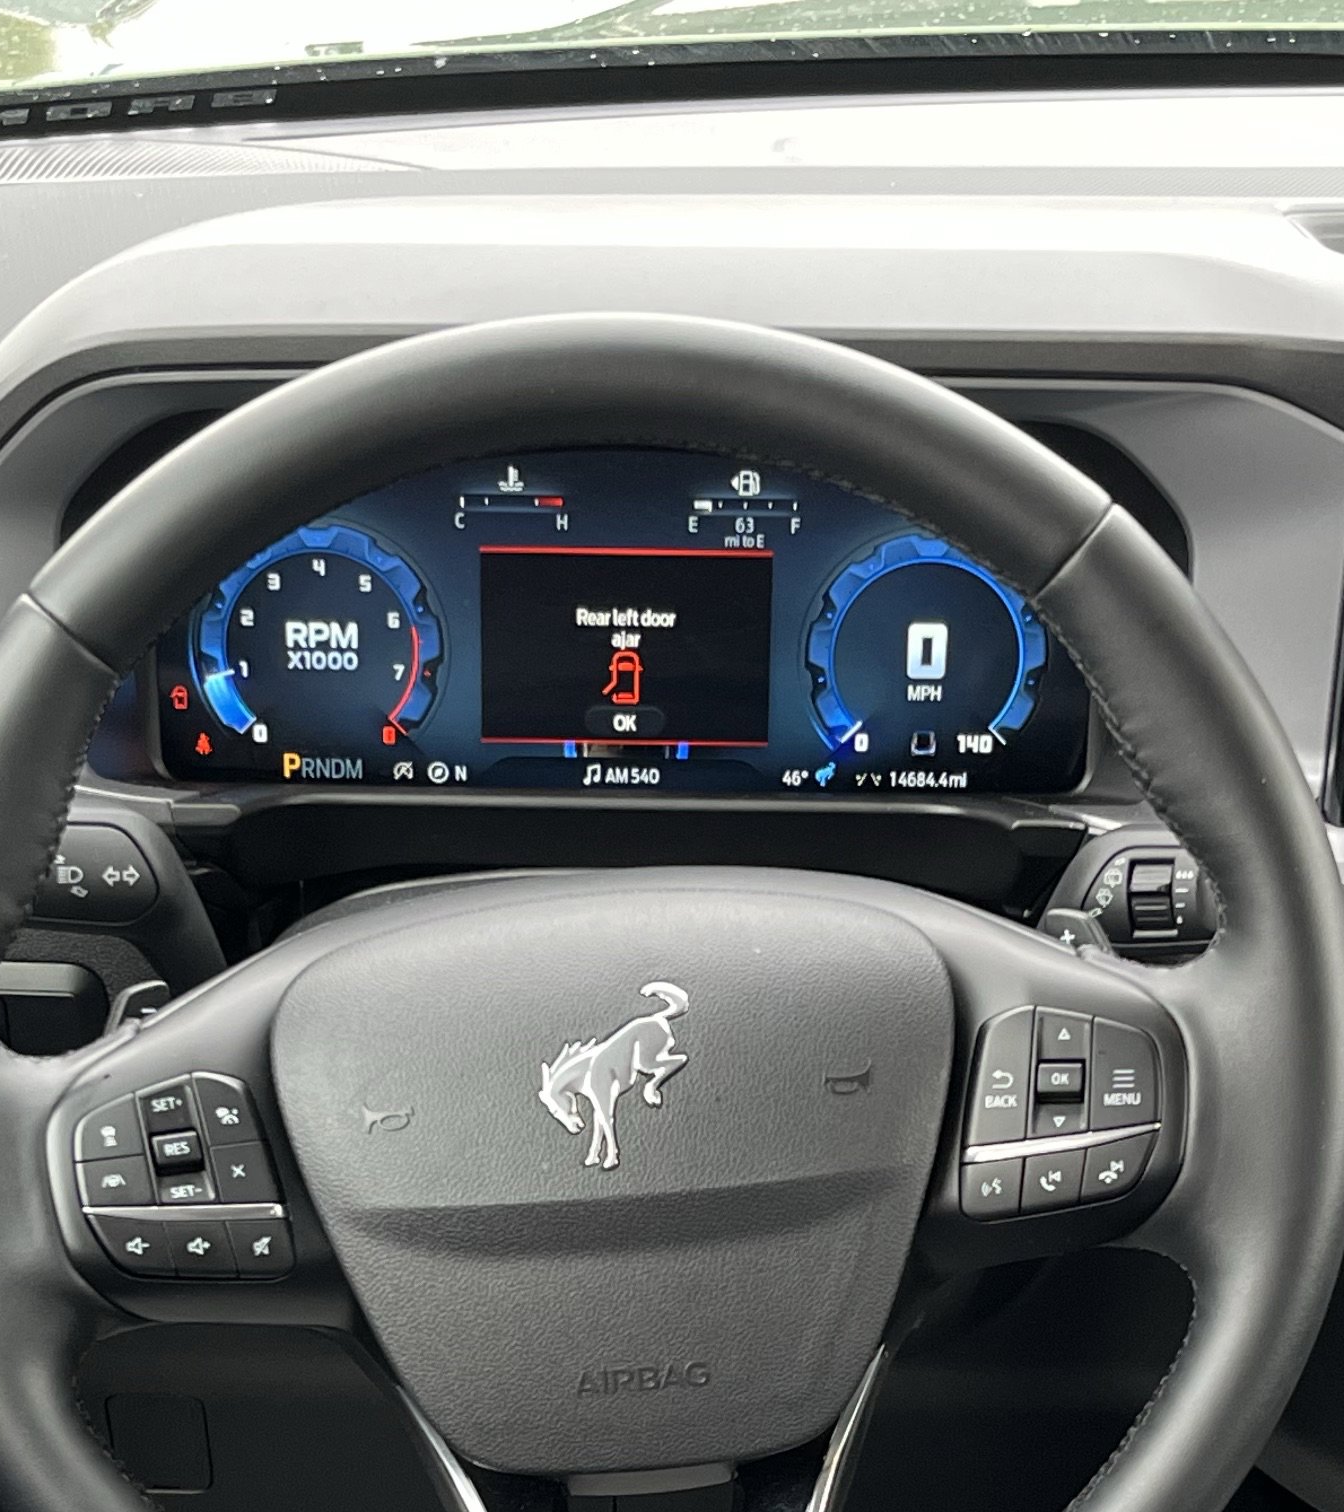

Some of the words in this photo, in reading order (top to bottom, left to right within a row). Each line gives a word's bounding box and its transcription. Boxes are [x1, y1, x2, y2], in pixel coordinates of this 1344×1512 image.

[454, 512, 465, 529] C
[556, 514, 568, 531] H
[688, 517, 699, 533] E
[735, 517, 755, 534] 63
[791, 519, 801, 535] F
[725, 534, 741, 549] mi
[756, 534, 765, 549] E
[312, 559, 325, 576] 4
[267, 573, 280, 591] 3
[359, 575, 372, 592] 5
[240, 610, 254, 627] 2
[387, 611, 401, 629] 6
[576, 607, 610, 627] Rear
[613, 608, 639, 627] left
[640, 609, 676, 628] door
[285, 621, 358, 649] RPM
[611, 630, 641, 650] ajar
[906, 622, 948, 680] 0
[239, 661, 249, 679] 1
[287, 652, 359, 671] X1000
[392, 664, 405, 682] 7
[907, 685, 942, 702] MPH
[612, 714, 637, 732] OK
[252, 725, 268, 743] 0
[854, 733, 869, 752] 0
[957, 733, 993, 753] 140
[455, 765, 468, 782] N
[605, 768, 629, 784] AM
[631, 768, 660, 784] 540
[782, 769, 809, 787] 46°
[1051, 1072, 1069, 1086] OK
[984, 1095, 1018, 1109] BACK
[1104, 1093, 1141, 1106] MENU
[163, 1141, 191, 1157] RES
[576, 1361, 710, 1398] AIRBAG
